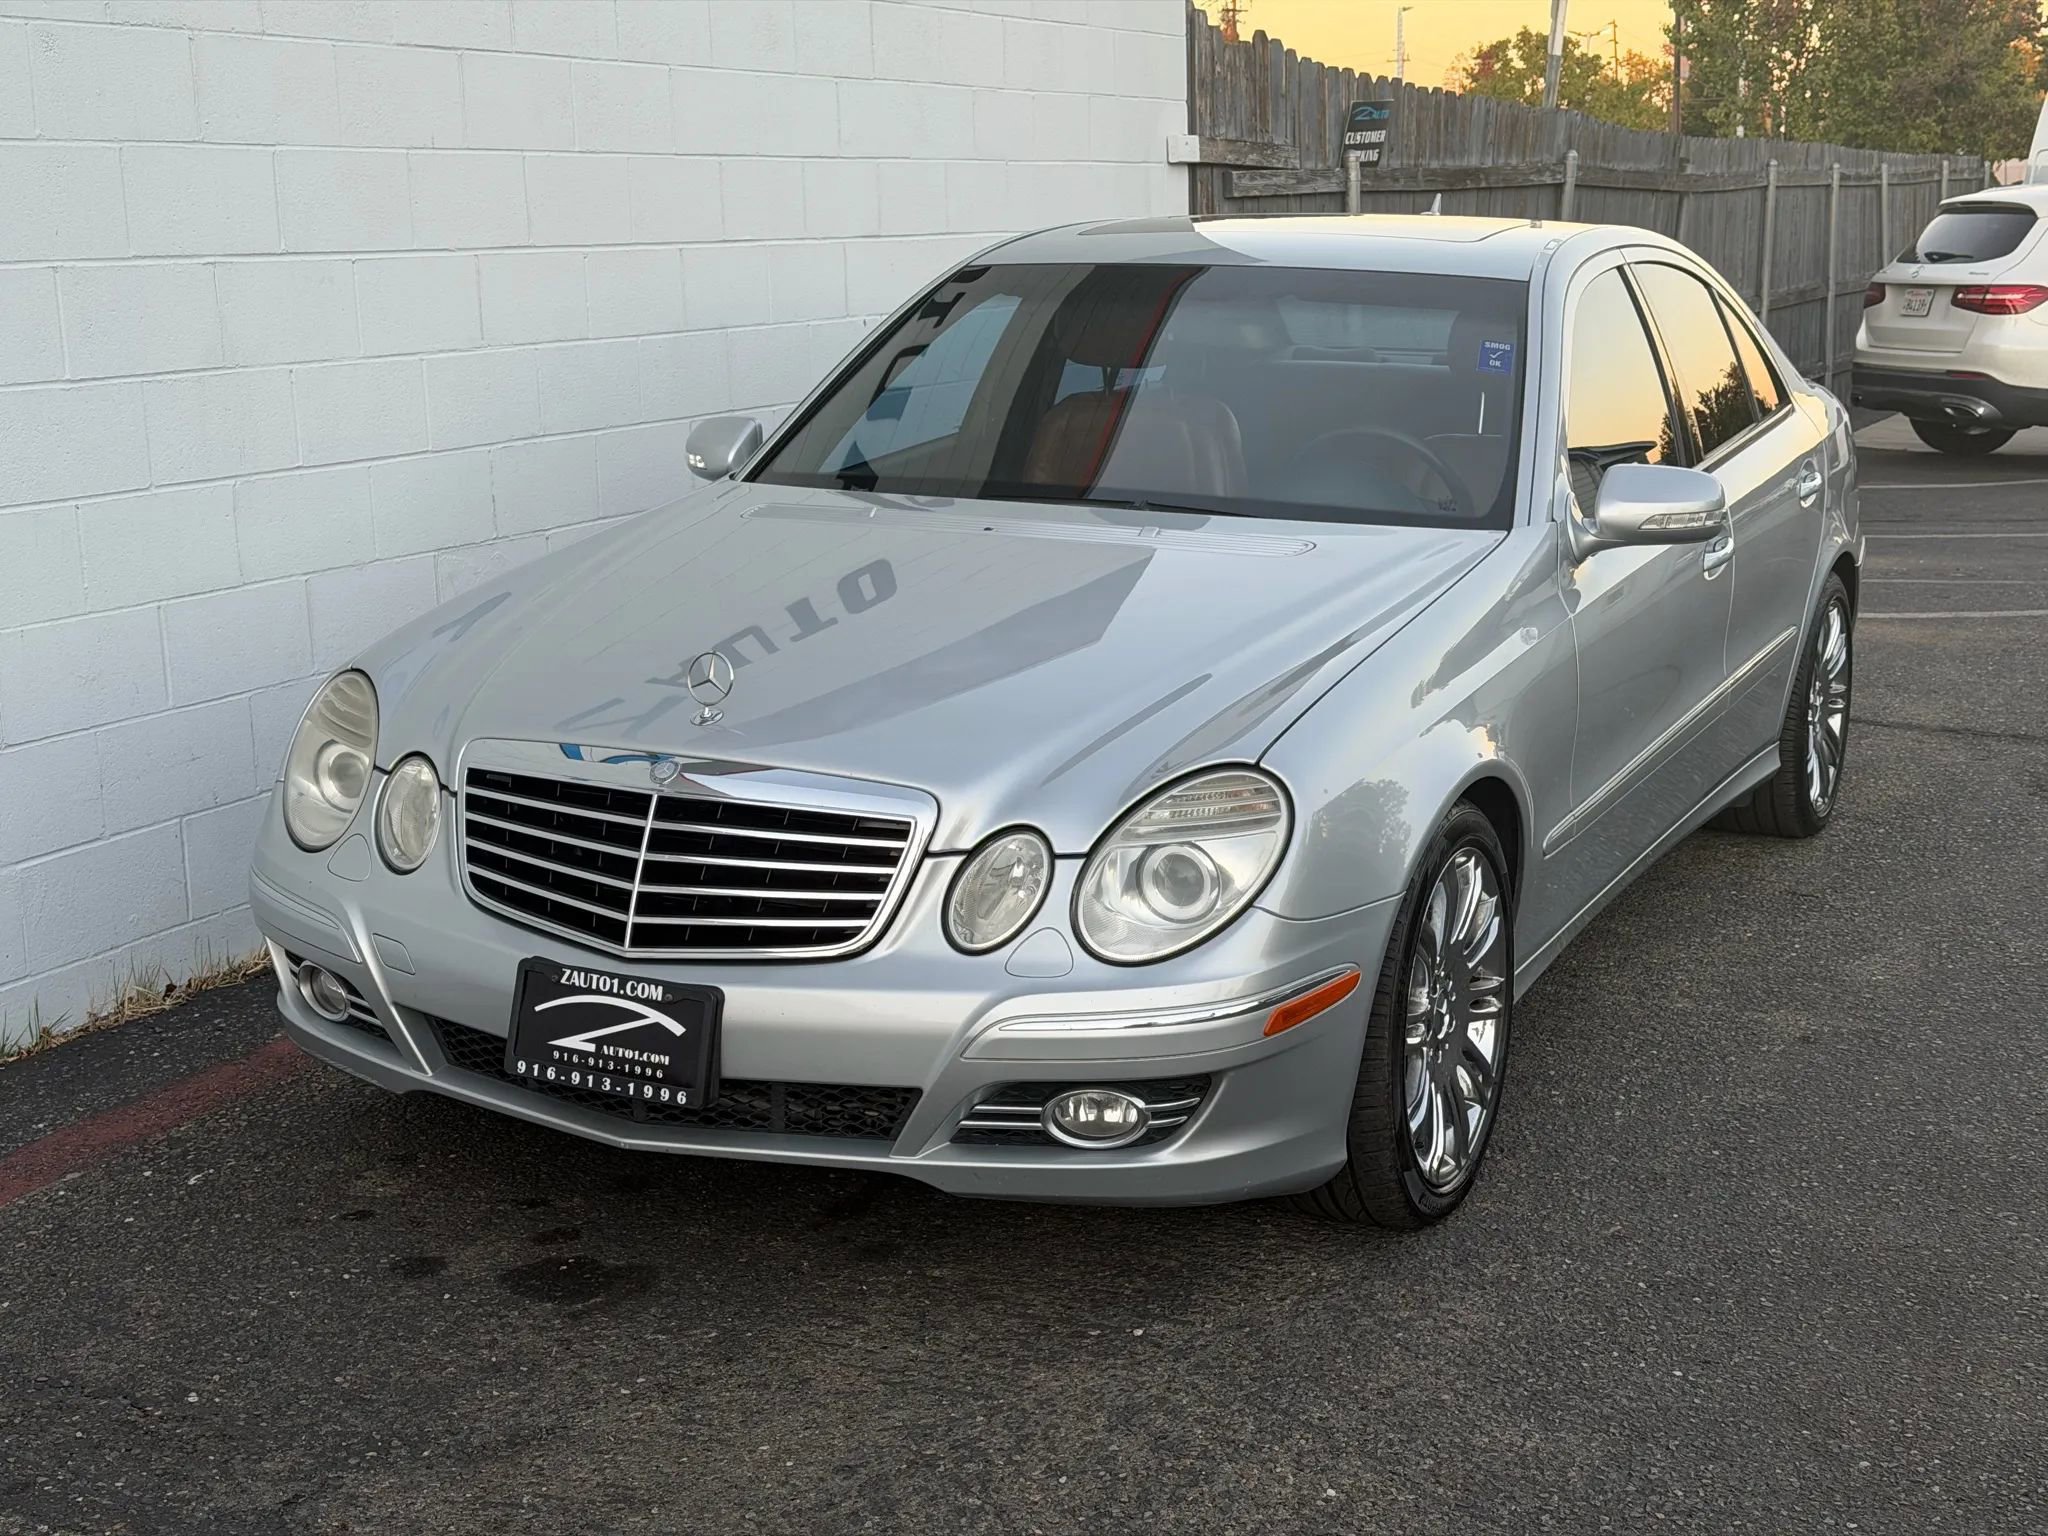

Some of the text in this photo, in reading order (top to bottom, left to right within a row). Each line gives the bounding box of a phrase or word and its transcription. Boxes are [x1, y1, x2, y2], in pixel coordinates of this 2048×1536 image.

[1345, 129, 1386, 145] CUSTOMER
[1484, 341, 1511, 351] SMOG
[1489, 359, 1502, 367] OK
[560, 968, 664, 1002] ZAUTO1.COM
[553, 1050, 664, 1079] 916-913-1996
[516, 1060, 688, 1105] 916-913-1996
